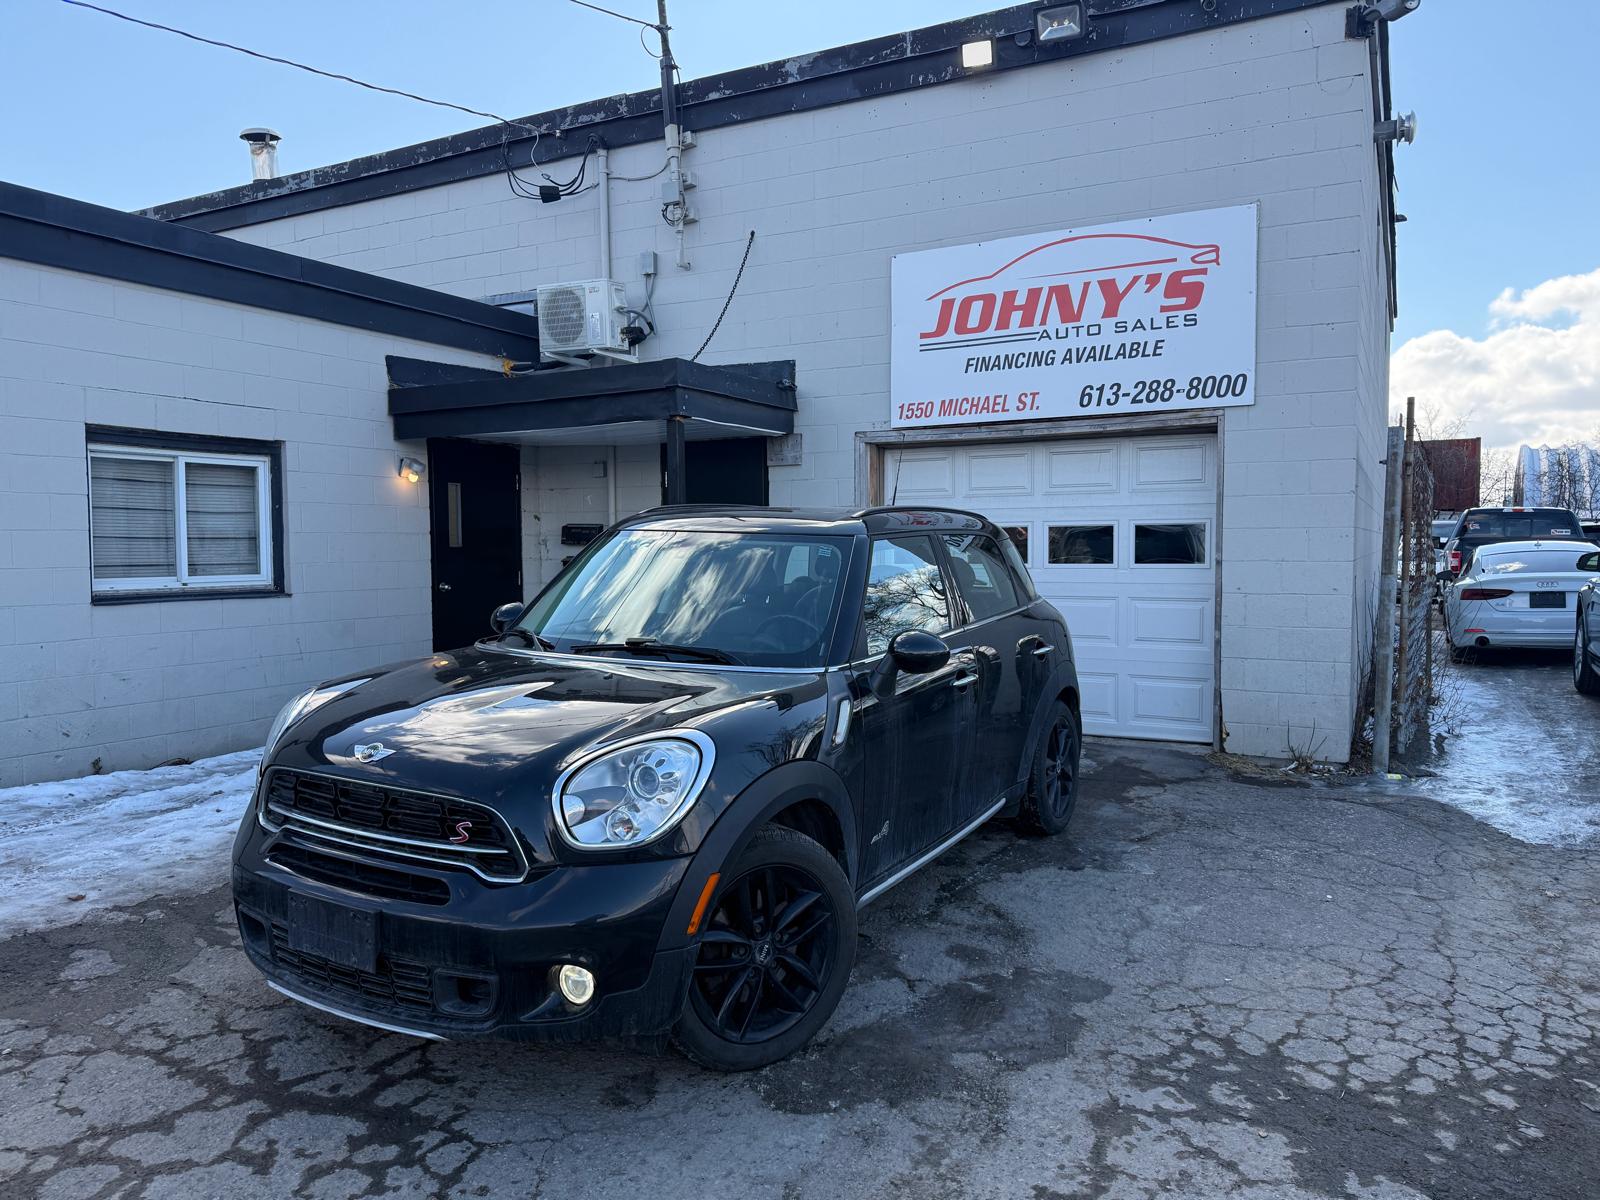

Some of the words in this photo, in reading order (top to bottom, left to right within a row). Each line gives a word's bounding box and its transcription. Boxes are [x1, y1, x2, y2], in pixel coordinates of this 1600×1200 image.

[919, 267, 1208, 339] JOHNY'S
[1037, 323, 1101, 341] AUTO
[1114, 313, 1198, 333] SALES
[964, 349, 1056, 374] FINANCING
[1061, 339, 1165, 365] AVAILABLE
[898, 400, 934, 420] 1550
[937, 394, 1010, 417] MICHAEL
[1016, 391, 1040, 411] ST.
[1078, 373, 1248, 408] 613-288-8000
[449, 821, 472, 843] S
